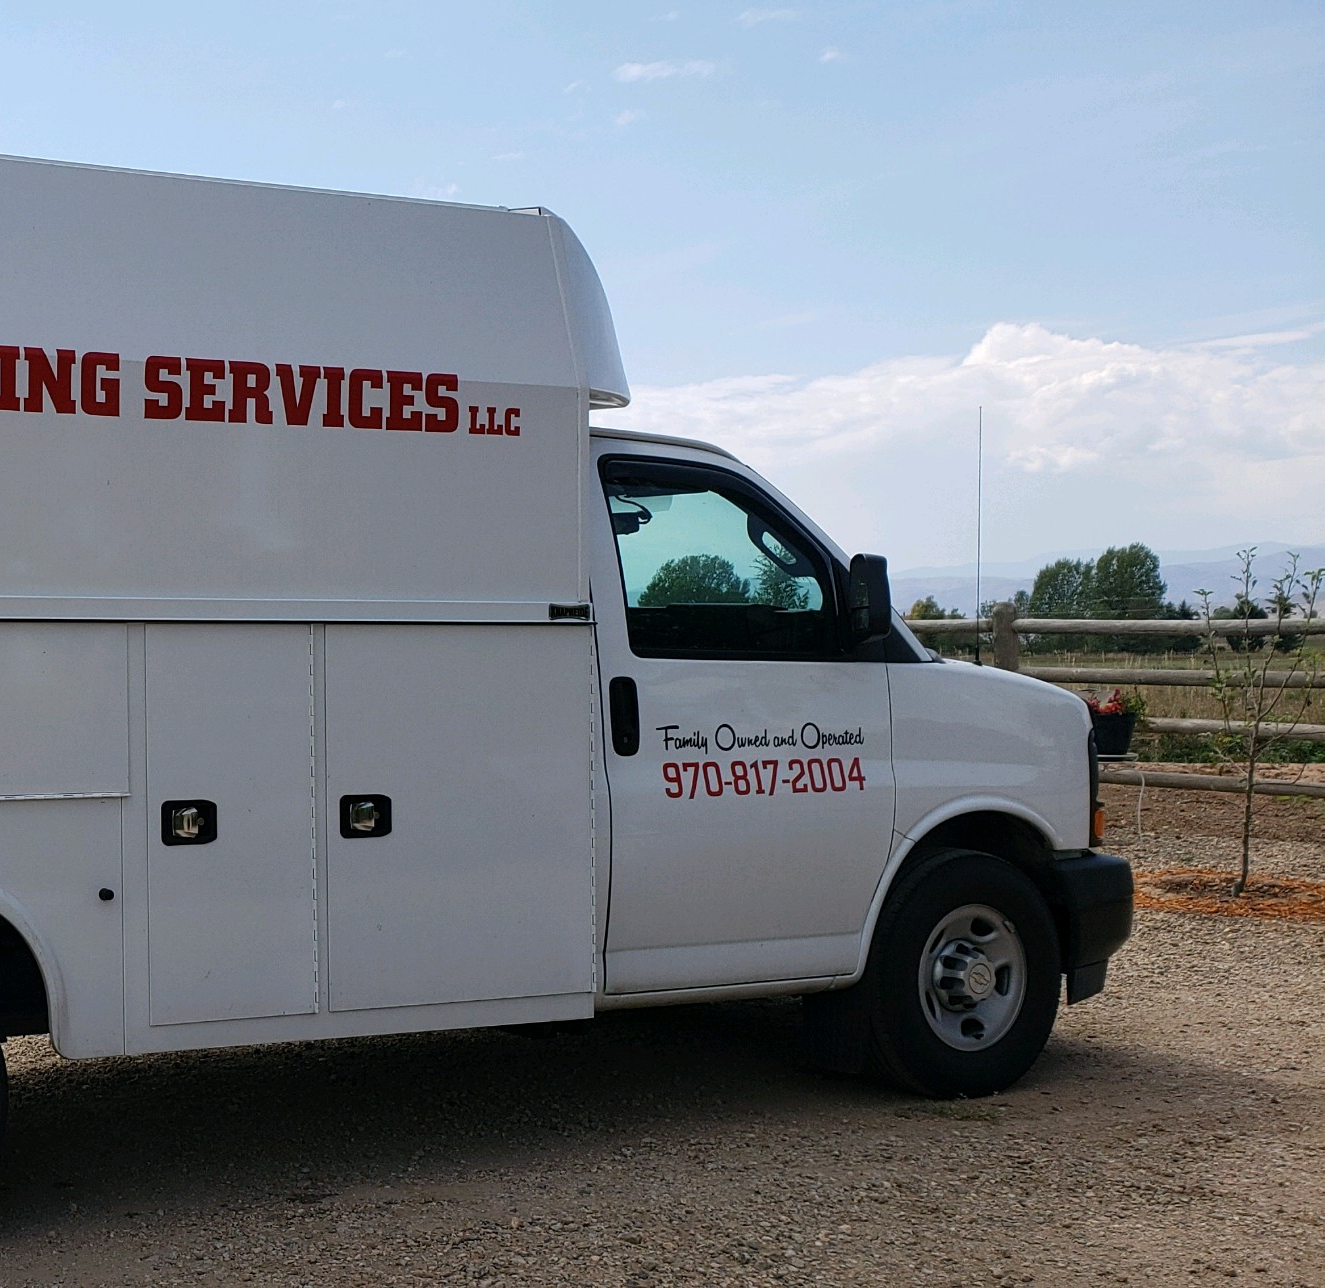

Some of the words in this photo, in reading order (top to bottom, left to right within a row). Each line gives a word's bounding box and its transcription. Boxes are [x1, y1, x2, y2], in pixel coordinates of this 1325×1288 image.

[143, 355, 459, 433] SERVICES
[468, 405, 521, 436] LLC
[656, 725, 708, 754] Family
[715, 724, 770, 751] Owned
[773, 729, 797, 747] and
[800, 722, 865, 749] Operated
[662, 757, 866, 799] 970-817-2004
